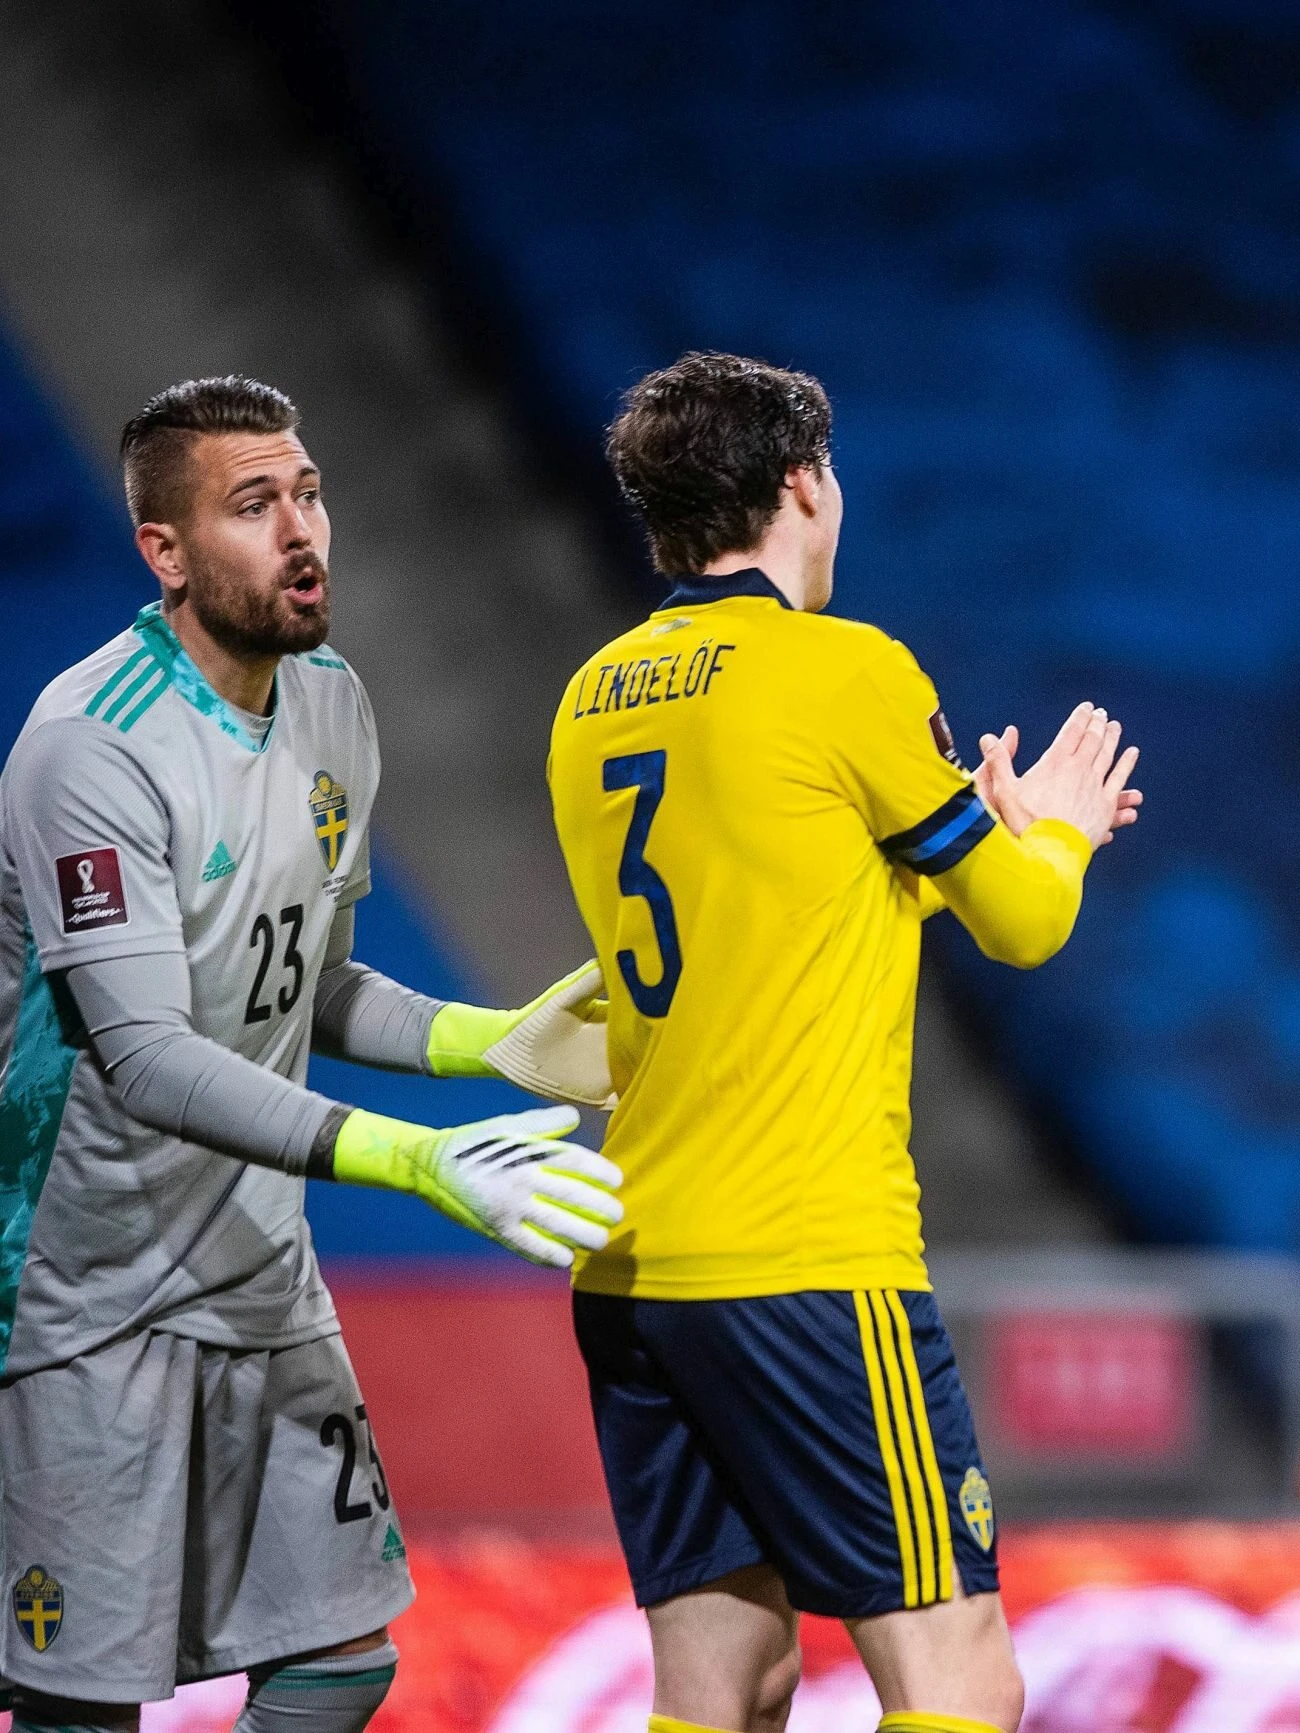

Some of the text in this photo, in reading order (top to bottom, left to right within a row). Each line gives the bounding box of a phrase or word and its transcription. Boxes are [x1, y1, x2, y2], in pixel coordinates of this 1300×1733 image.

[573, 638, 736, 721] LINDELÖF
[602, 749, 684, 1019] 3
[245, 903, 305, 1025] 23
